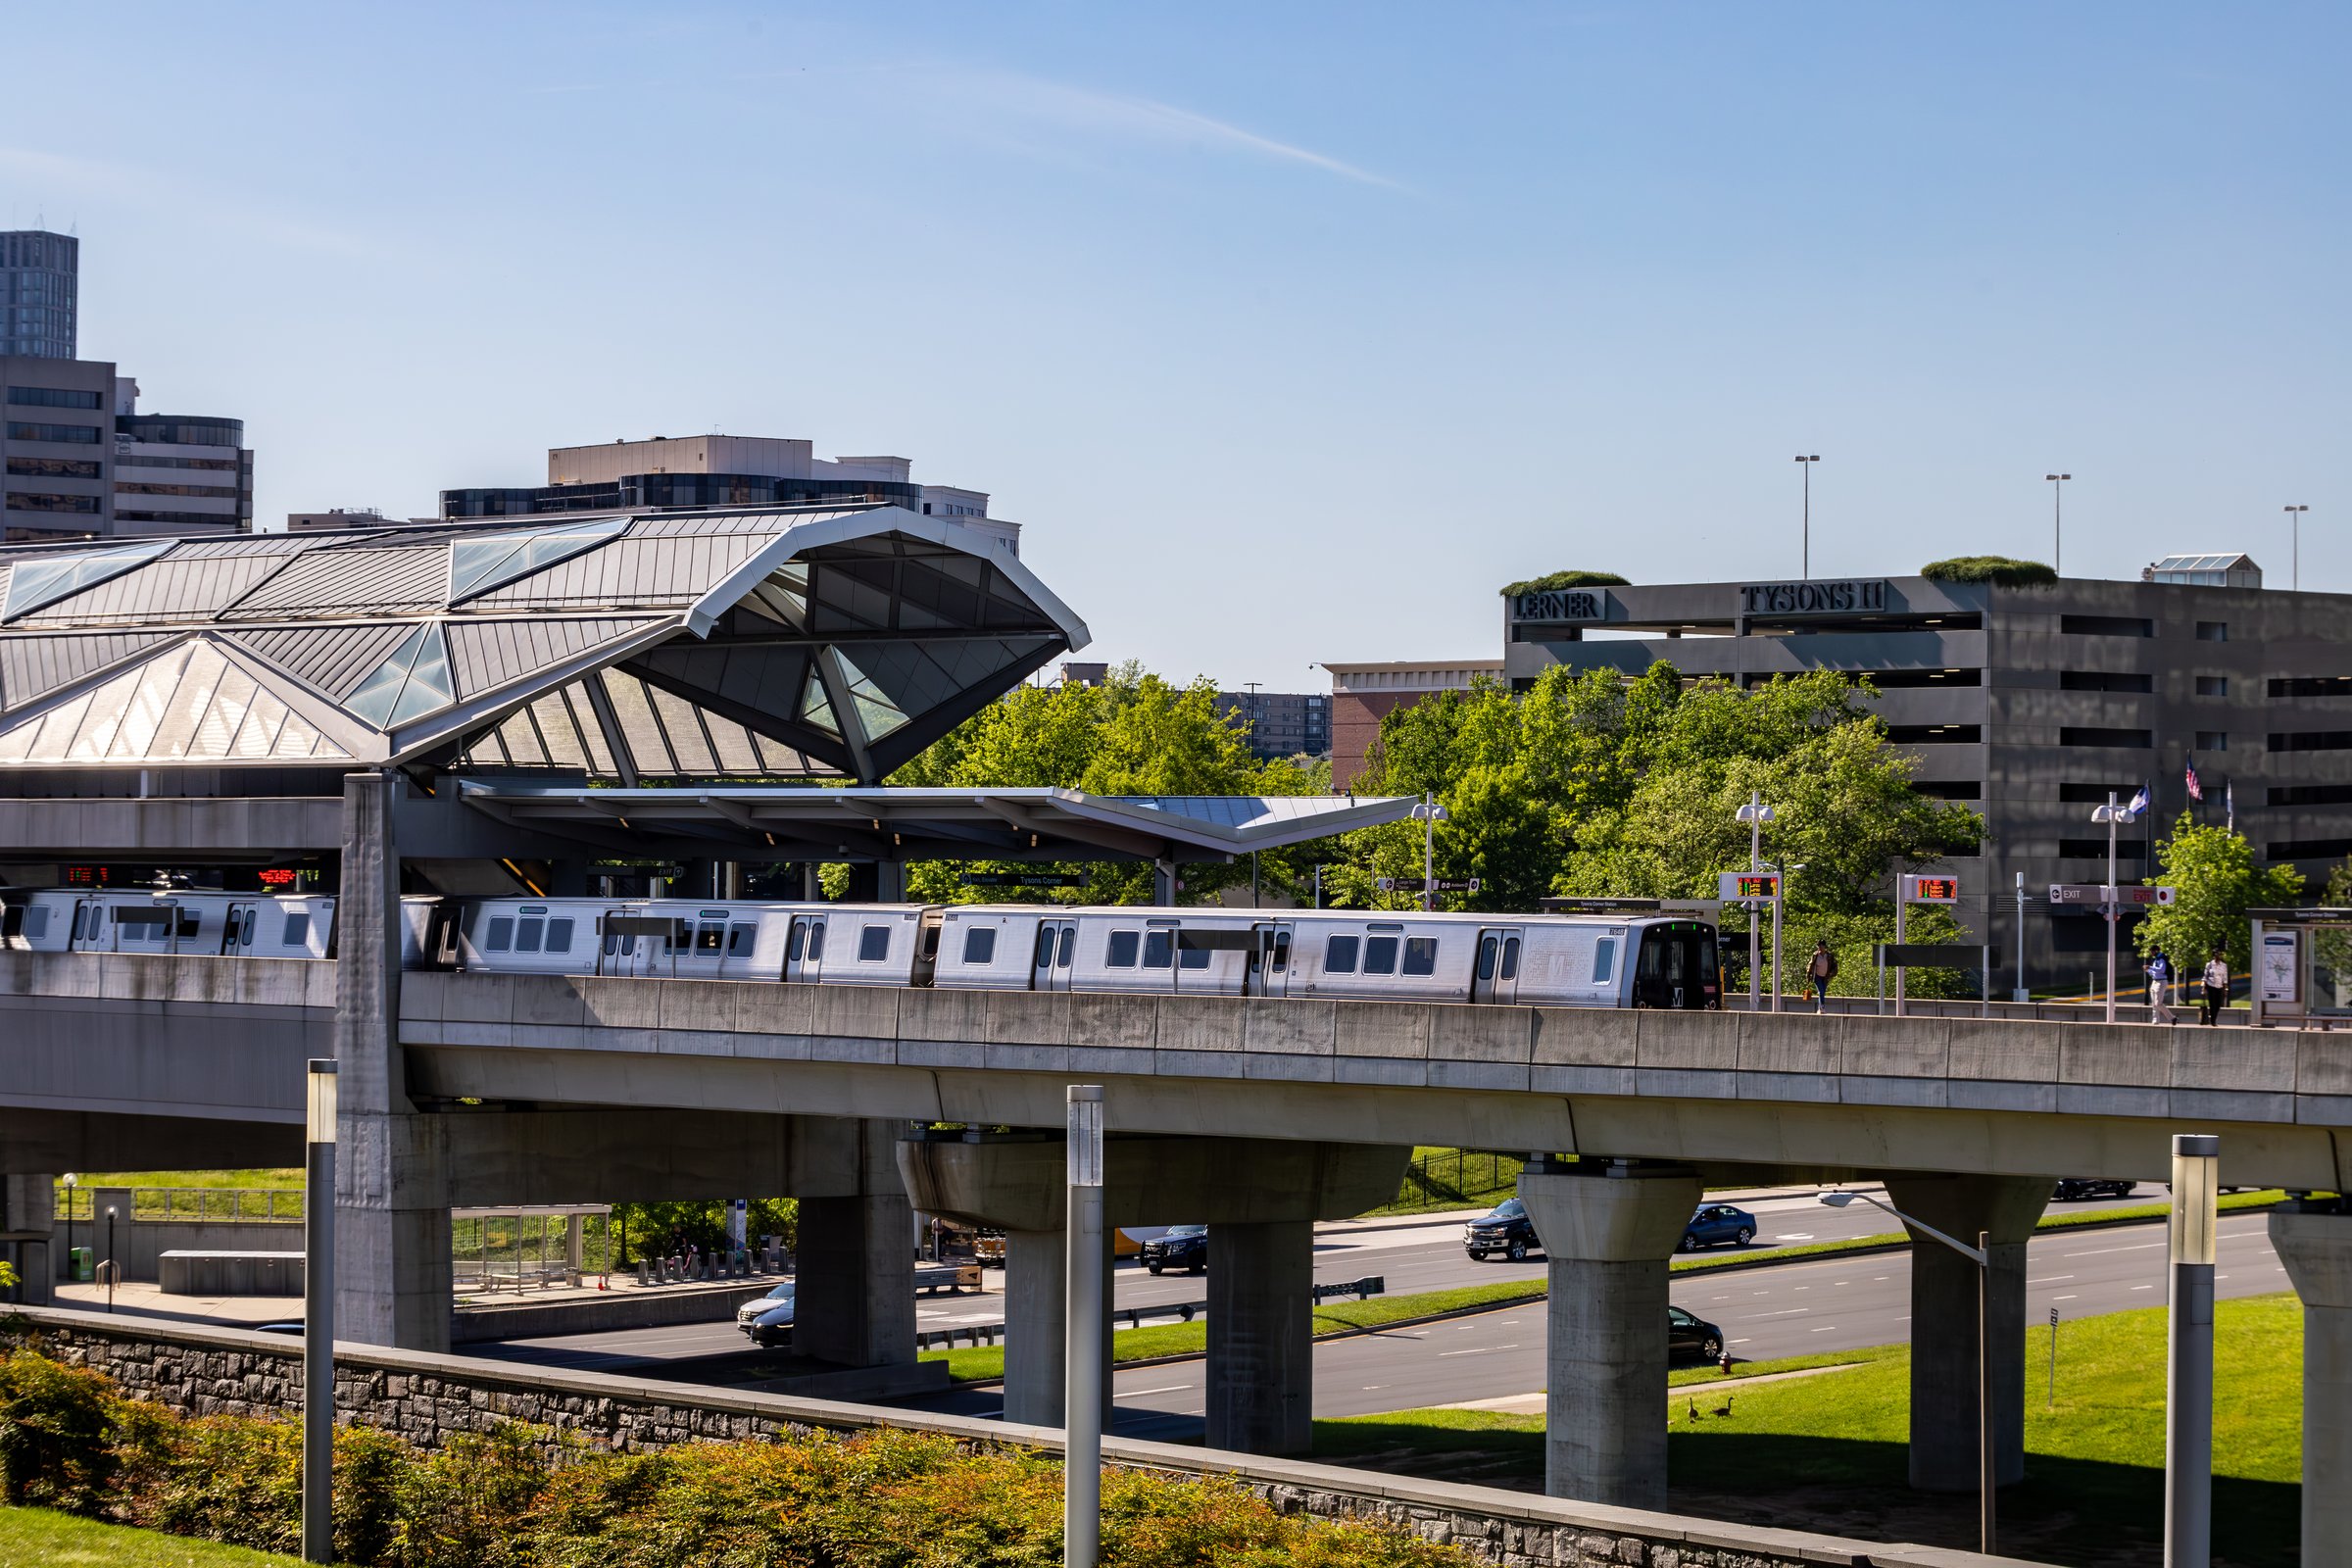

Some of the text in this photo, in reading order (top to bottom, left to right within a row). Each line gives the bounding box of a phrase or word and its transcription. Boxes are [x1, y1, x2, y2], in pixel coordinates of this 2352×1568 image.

[1740, 582, 1882, 612] TYSONS II
[1513, 593, 1598, 619] LERNER
[1020, 876, 1042, 885] Tysons
[2063, 890, 2081, 899] EXIT
